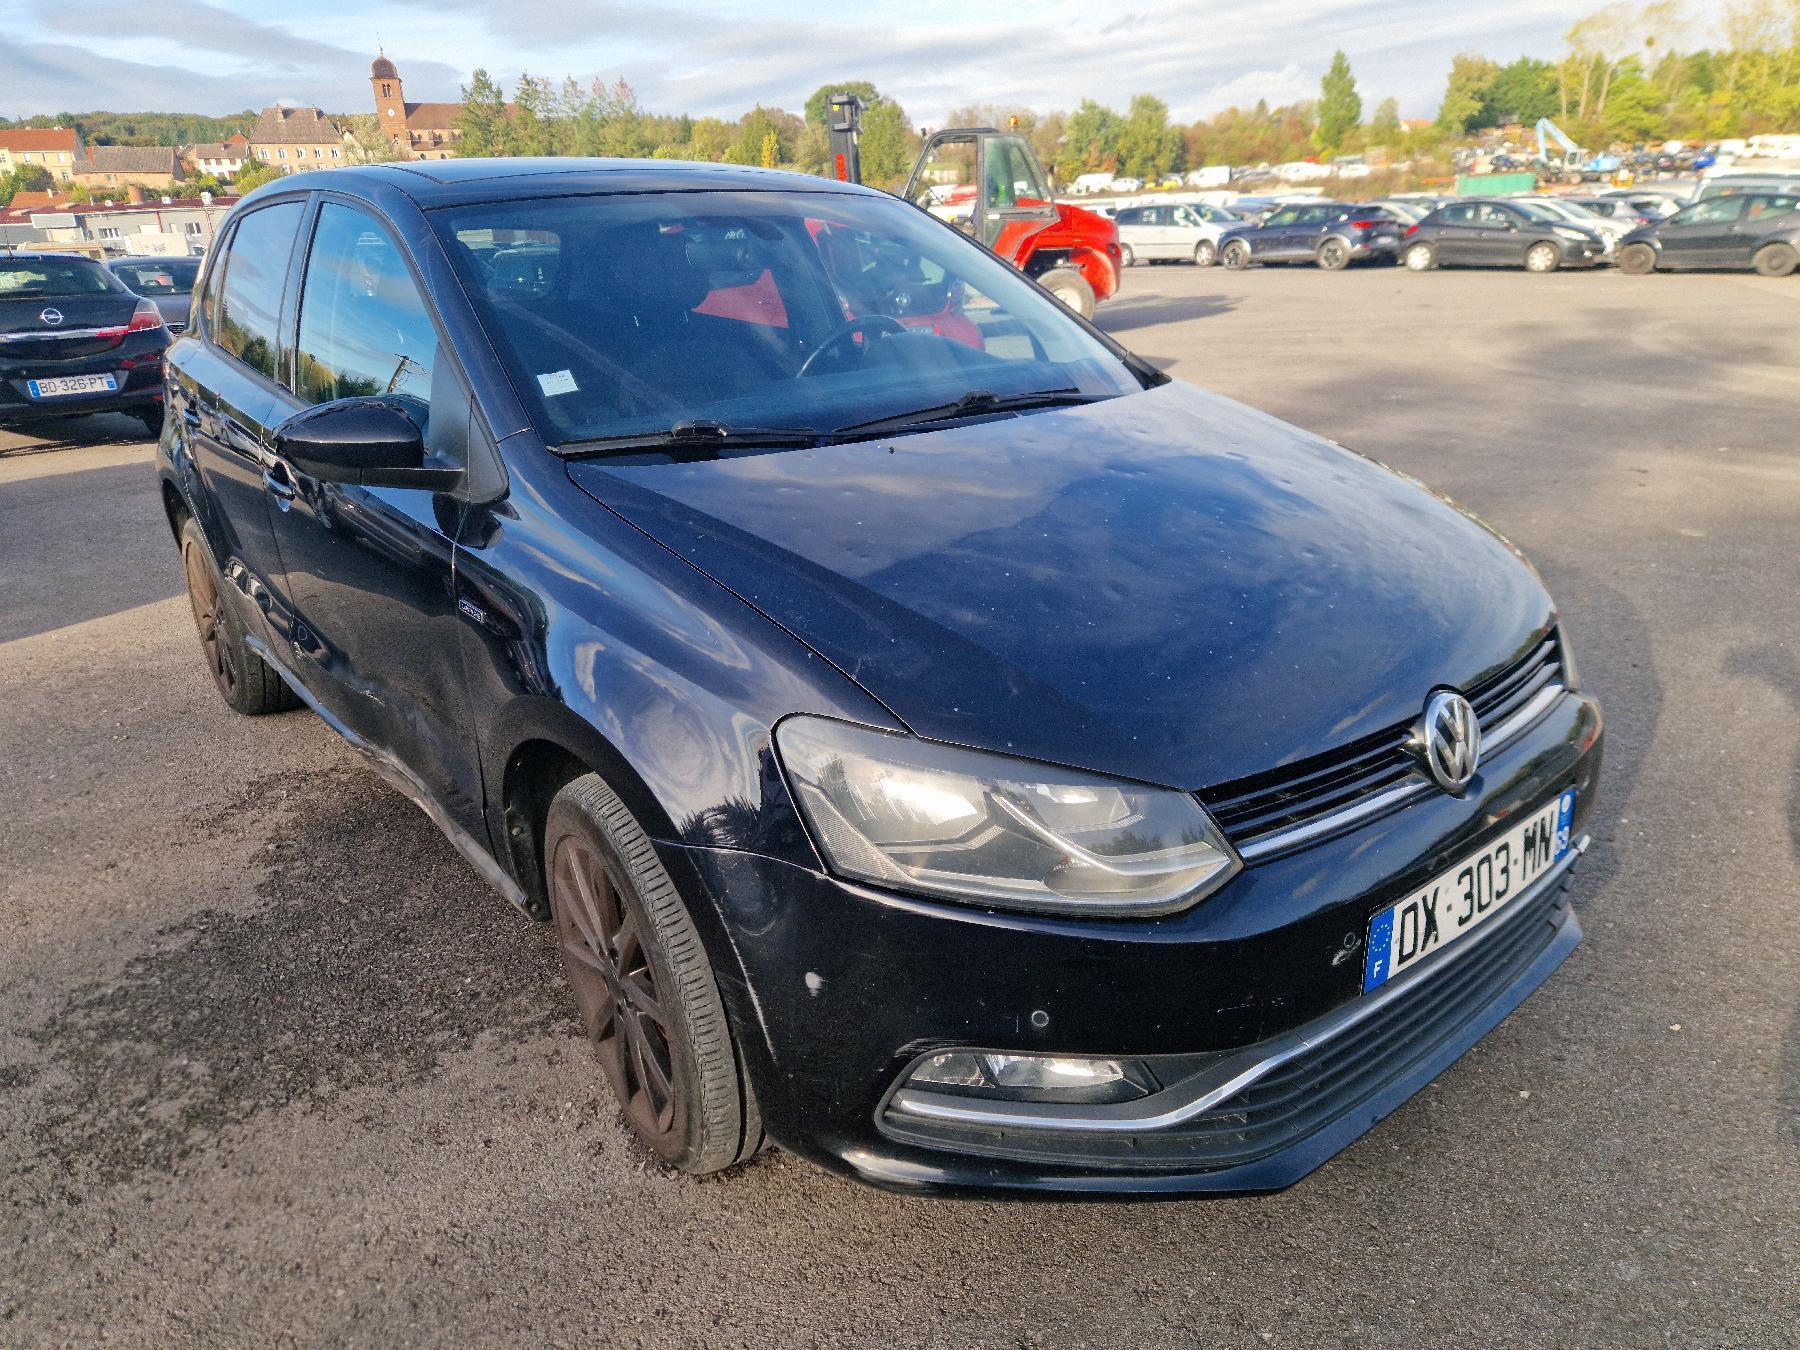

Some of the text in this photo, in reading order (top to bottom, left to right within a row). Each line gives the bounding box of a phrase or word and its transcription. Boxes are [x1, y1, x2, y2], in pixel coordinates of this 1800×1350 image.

[40, 377, 104, 393] BD-326-PT
[1398, 810, 1554, 966] DX-303-MN
[1373, 960, 1383, 979] F
